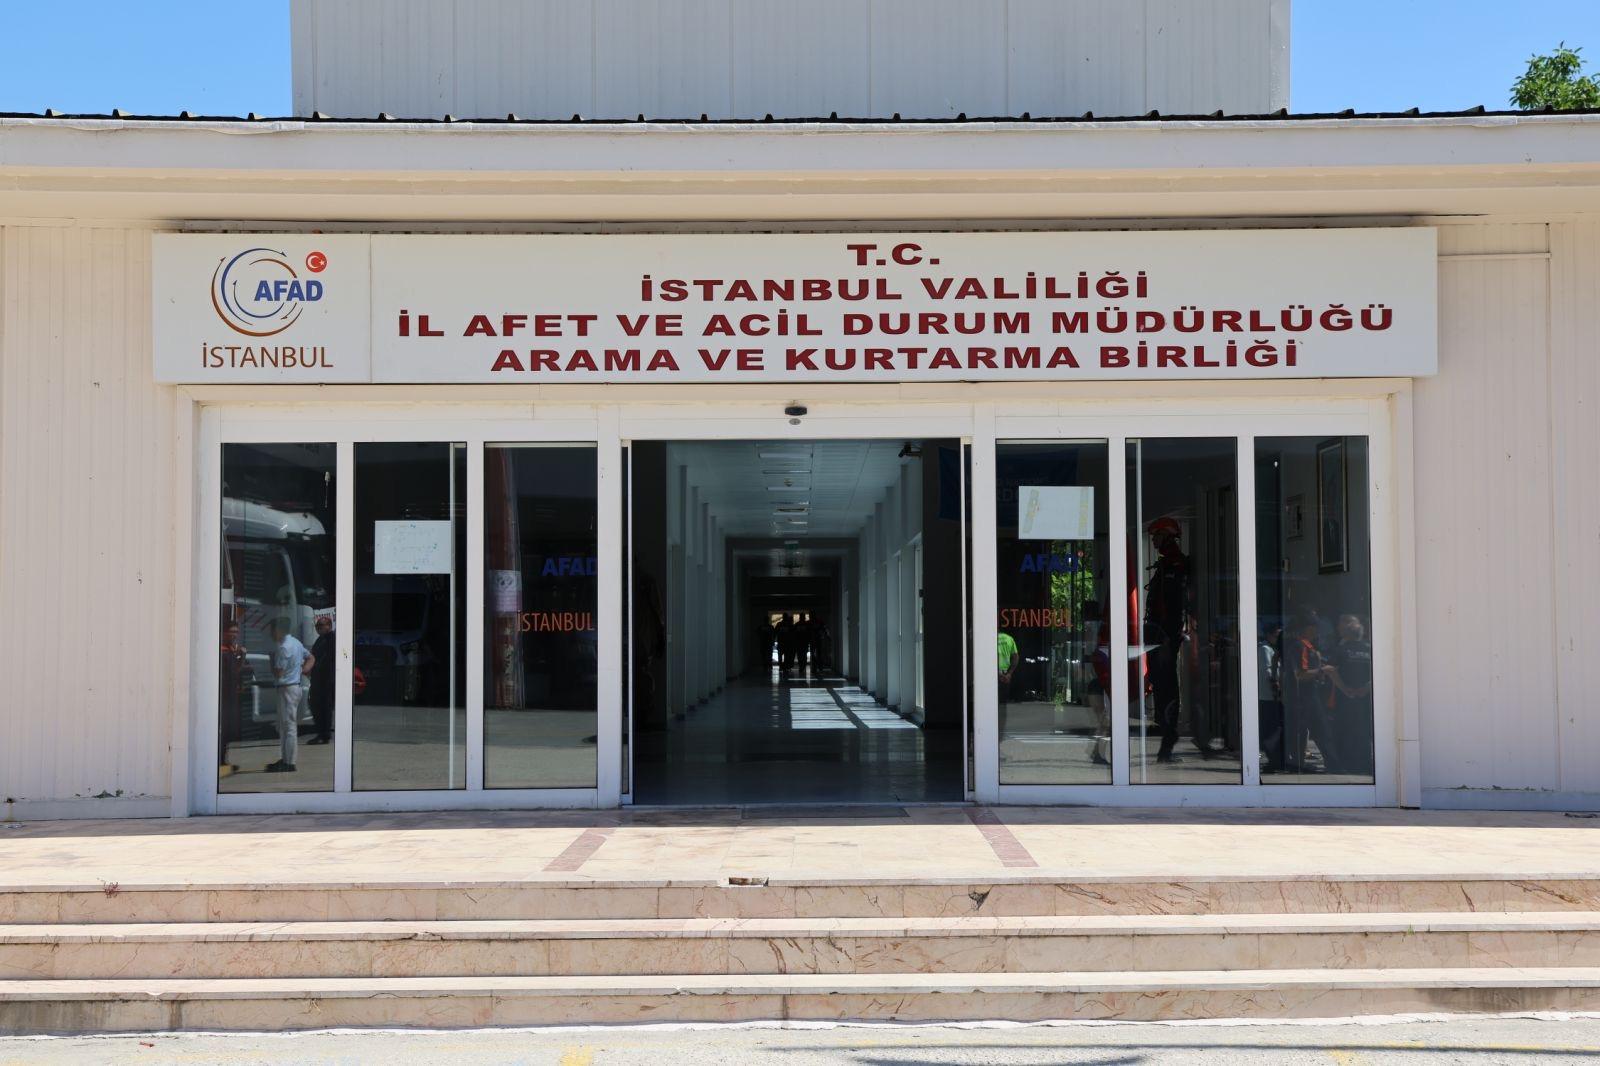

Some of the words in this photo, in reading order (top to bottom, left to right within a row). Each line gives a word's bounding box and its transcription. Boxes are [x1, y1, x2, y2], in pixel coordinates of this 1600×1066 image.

[847, 243, 940, 266] T.C.
[255, 280, 324, 302] AFAD
[642, 275, 901, 303] İSTANBUL
[920, 271, 1148, 300] VALİLİĞİ
[398, 309, 444, 337] İL
[463, 314, 599, 337] AFET
[617, 314, 683, 337] VE
[702, 307, 822, 337] ACİL
[842, 312, 1031, 336] DURUM
[1051, 304, 1393, 334] MÜDÜRLÜĞÜ
[202, 342, 333, 368] İSTANBUL
[491, 349, 679, 372] ARAMA
[698, 349, 765, 372] VE
[785, 346, 1079, 371] KURTARMA
[1099, 339, 1298, 369] BİRLİĞİ
[999, 607, 1073, 629] STANBUL
